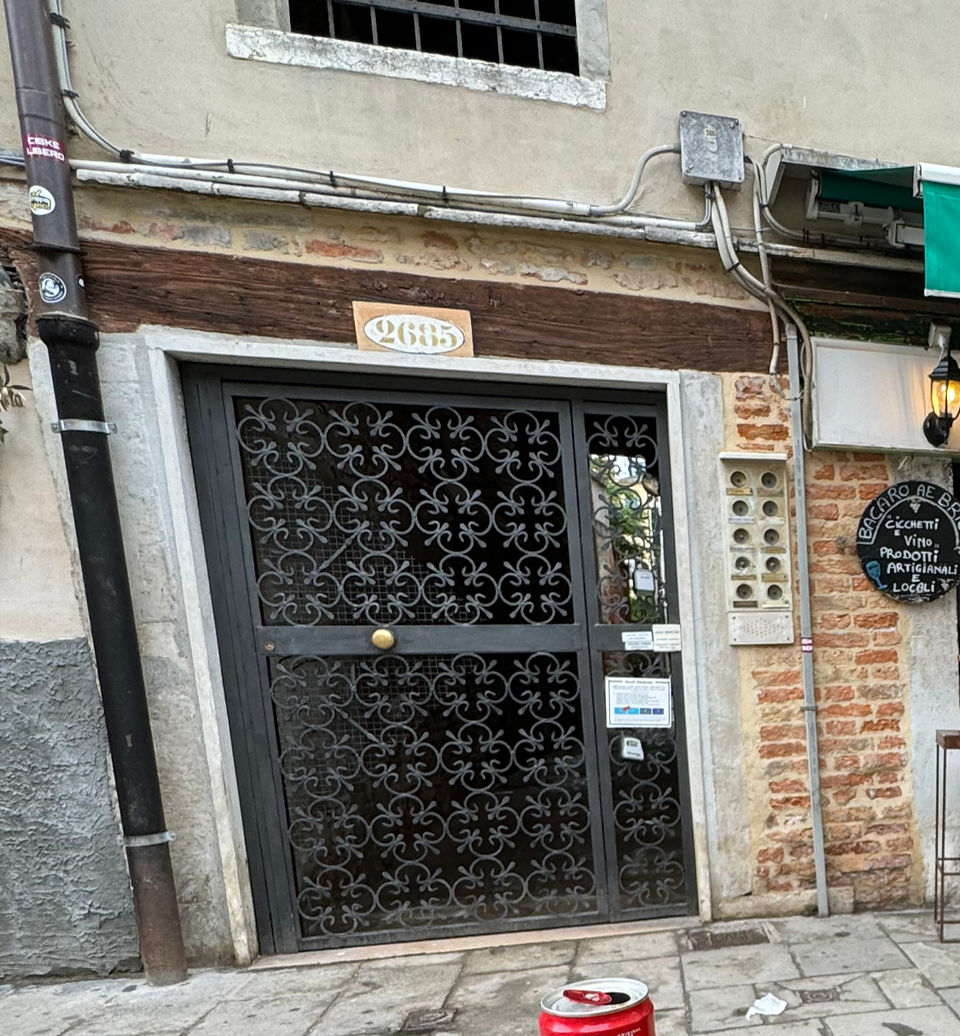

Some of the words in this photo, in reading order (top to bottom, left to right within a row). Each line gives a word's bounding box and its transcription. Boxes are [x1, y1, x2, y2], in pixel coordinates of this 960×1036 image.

[375, 319, 458, 348] 2685
[858, 485, 910, 539] BACARO
[916, 484, 936, 499] AE
[911, 574, 921, 583] E
